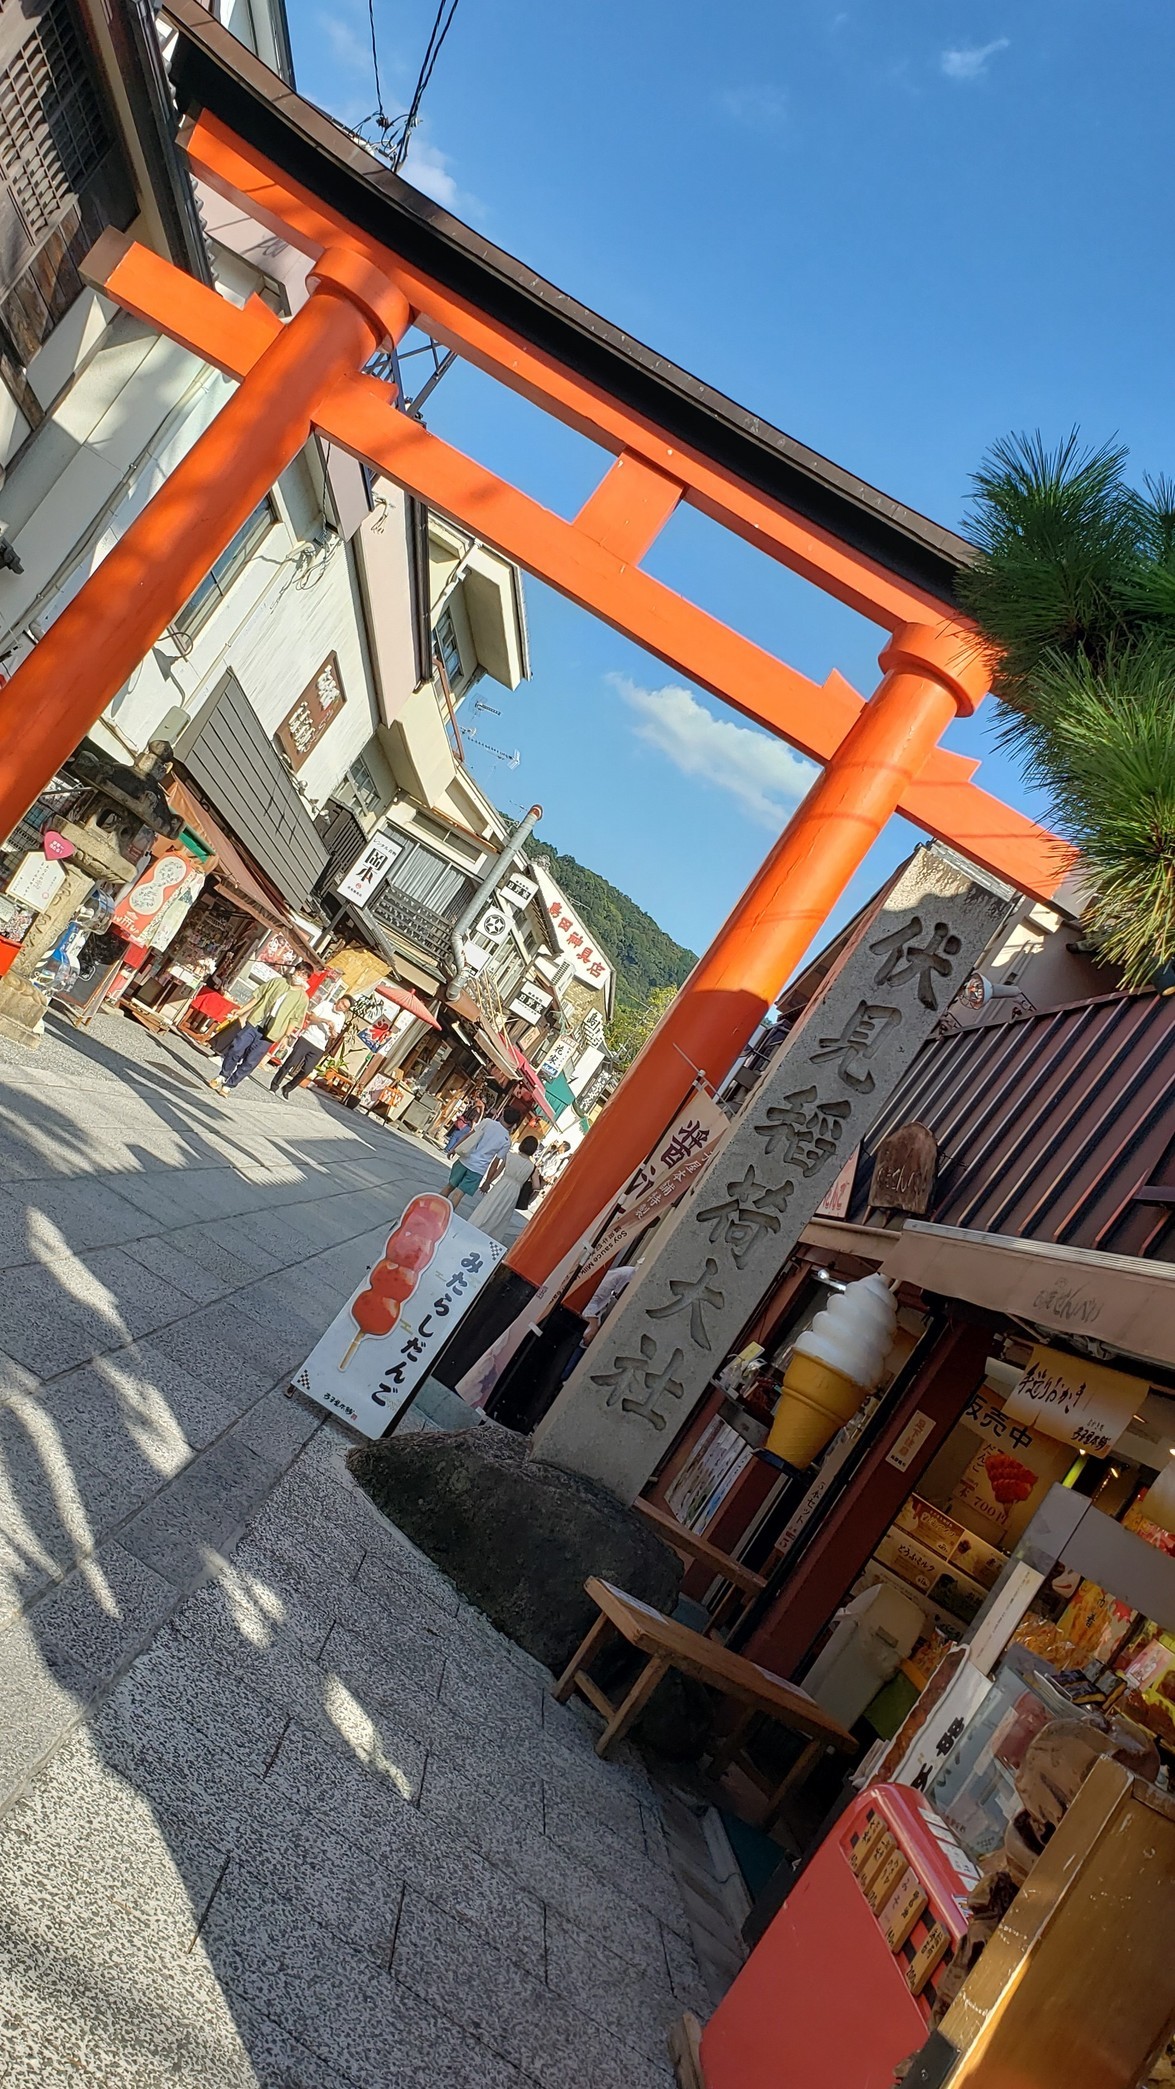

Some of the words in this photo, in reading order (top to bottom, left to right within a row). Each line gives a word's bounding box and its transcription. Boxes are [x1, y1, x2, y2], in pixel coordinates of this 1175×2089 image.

[355, 847, 387, 884] 岡本
[507, 881, 529, 898] 日野家
[547, 900, 606, 978] 島田神具店
[518, 993, 543, 1013] 日野家
[590, 915, 962, 1431] 伏見稲荷大社
[613, 1230, 627, 1242] Soy
[593, 1244, 613, 1264] sauce
[580, 1262, 594, 1275] Milk
[371, 1251, 479, 1406] みたらしだんご
[972, 1496, 1007, 1524] 700円
